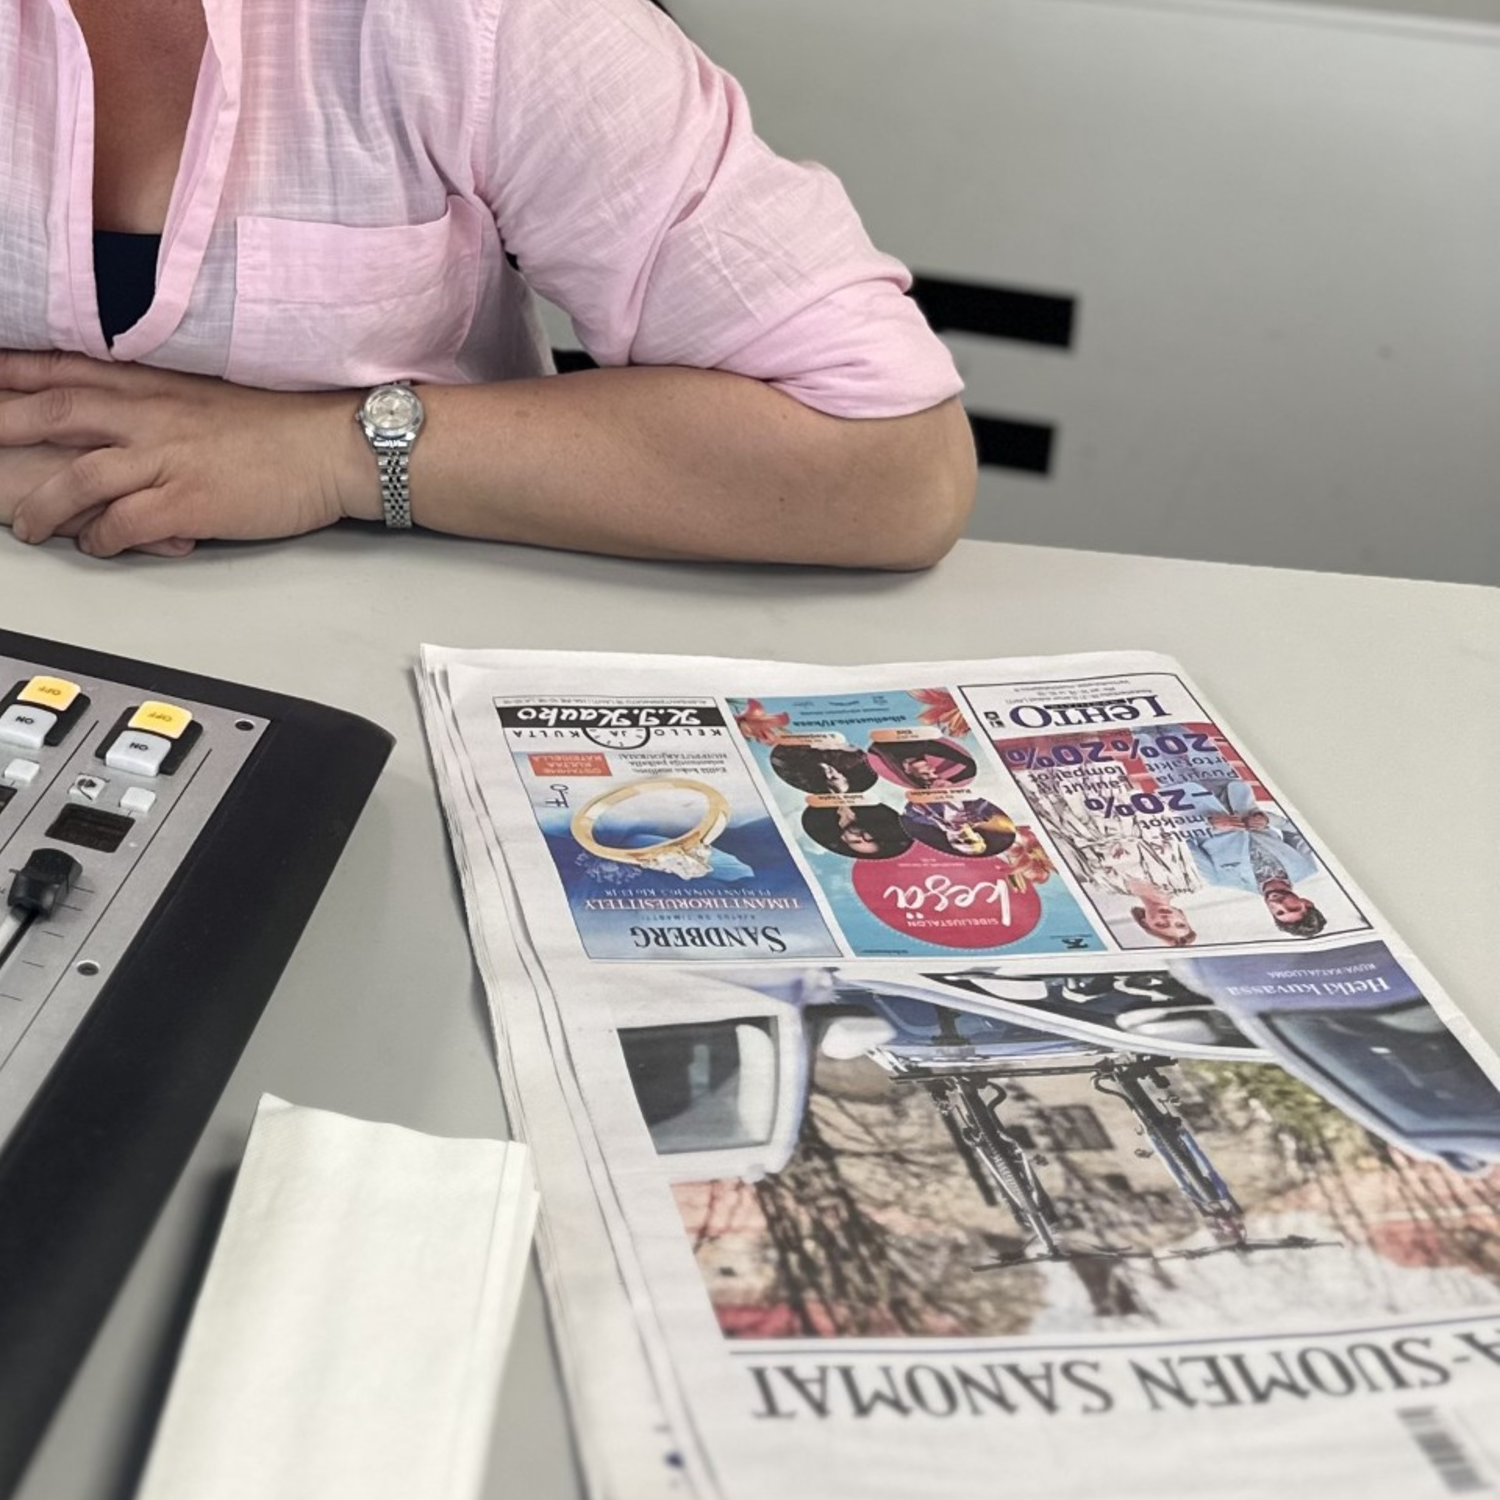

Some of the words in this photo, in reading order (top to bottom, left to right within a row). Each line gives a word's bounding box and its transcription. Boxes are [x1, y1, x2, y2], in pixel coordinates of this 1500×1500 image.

[15, 715, 35, 726] ON
[512, 730, 580, 739] KULTA
[609, 730, 627, 738] JA
[654, 728, 722, 738] KELLO
[129, 741, 149, 752] ON
[1027, 765, 1125, 783] lompakot
[1156, 771, 1174, 785] ja
[1176, 768, 1239, 782] Puvut
[1063, 776, 1134, 796] Laukut
[1083, 789, 1213, 819] -20%
[1139, 814, 1207, 830] mekot
[681, 887, 770, 896] PERJANTAINA
[584, 897, 800, 911] TIMANTTIKORUESITTELY
[882, 874, 1011, 927] kesä
[907, 917, 999, 927] SIBELIUSTALON
[629, 925, 787, 953] SANDBERG
[1224, 982, 1322, 997] kuvassa
[1322, 977, 1391, 996] Hetki
[746, 1360, 1114, 1420] SANOMAT
